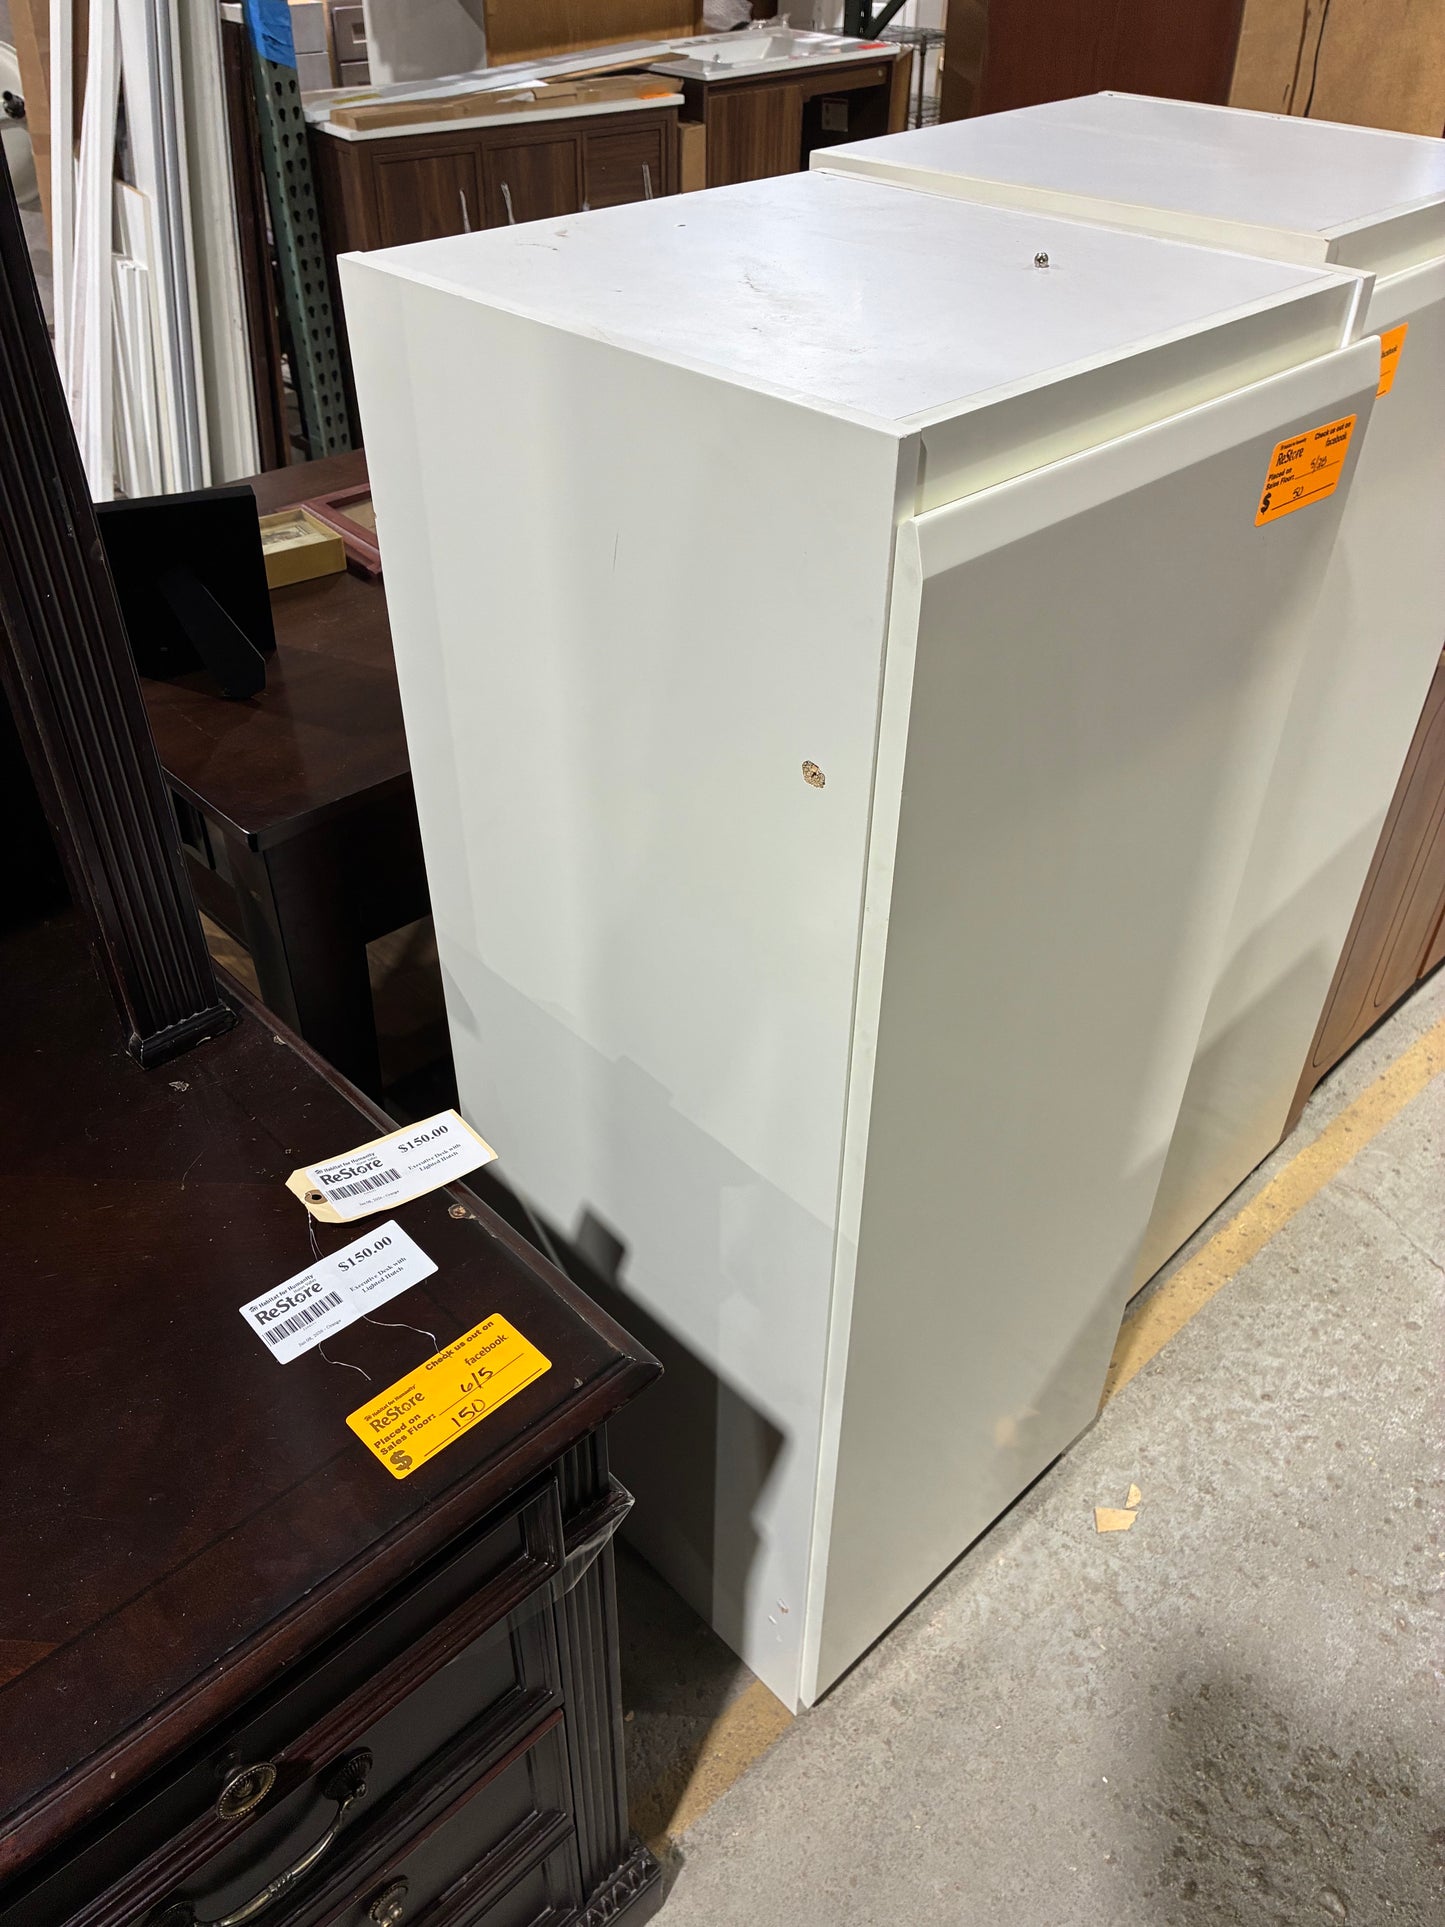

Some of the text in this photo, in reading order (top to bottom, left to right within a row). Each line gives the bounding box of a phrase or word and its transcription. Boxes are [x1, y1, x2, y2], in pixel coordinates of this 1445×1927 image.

[1276, 447, 1304, 467] ReStore
[1268, 468, 1286, 481] Placed
[1260, 493, 1272, 515] $
[398, 1125, 449, 1154] $150.00
[324, 1163, 342, 1173] Habitat
[351, 1152, 375, 1164] Humanity
[408, 1156, 434, 1171] Executive
[449, 1143, 461, 1153] with
[320, 1159, 383, 1186] ReStore
[338, 1236, 392, 1272] $150.00
[349, 1257, 407, 1292] Executive Desk with
[362, 1266, 404, 1293] Lighted Hutch
[254, 1282, 323, 1326] ReStore
[258, 1274, 314, 1308] Habitat for Humanity
[425, 1321, 494, 1371] Check us out on
[464, 1334, 508, 1367] facebook
[460, 1367, 493, 1393] 6/5
[369, 1392, 425, 1433] ReStore
[372, 1404, 388, 1417] Habitat
[394, 1384, 416, 1402] Humanity
[451, 1398, 486, 1427] 150
[374, 1414, 421, 1449] Placed on
[380, 1413, 437, 1455] Sales Floor:
[390, 1449, 413, 1471] $
